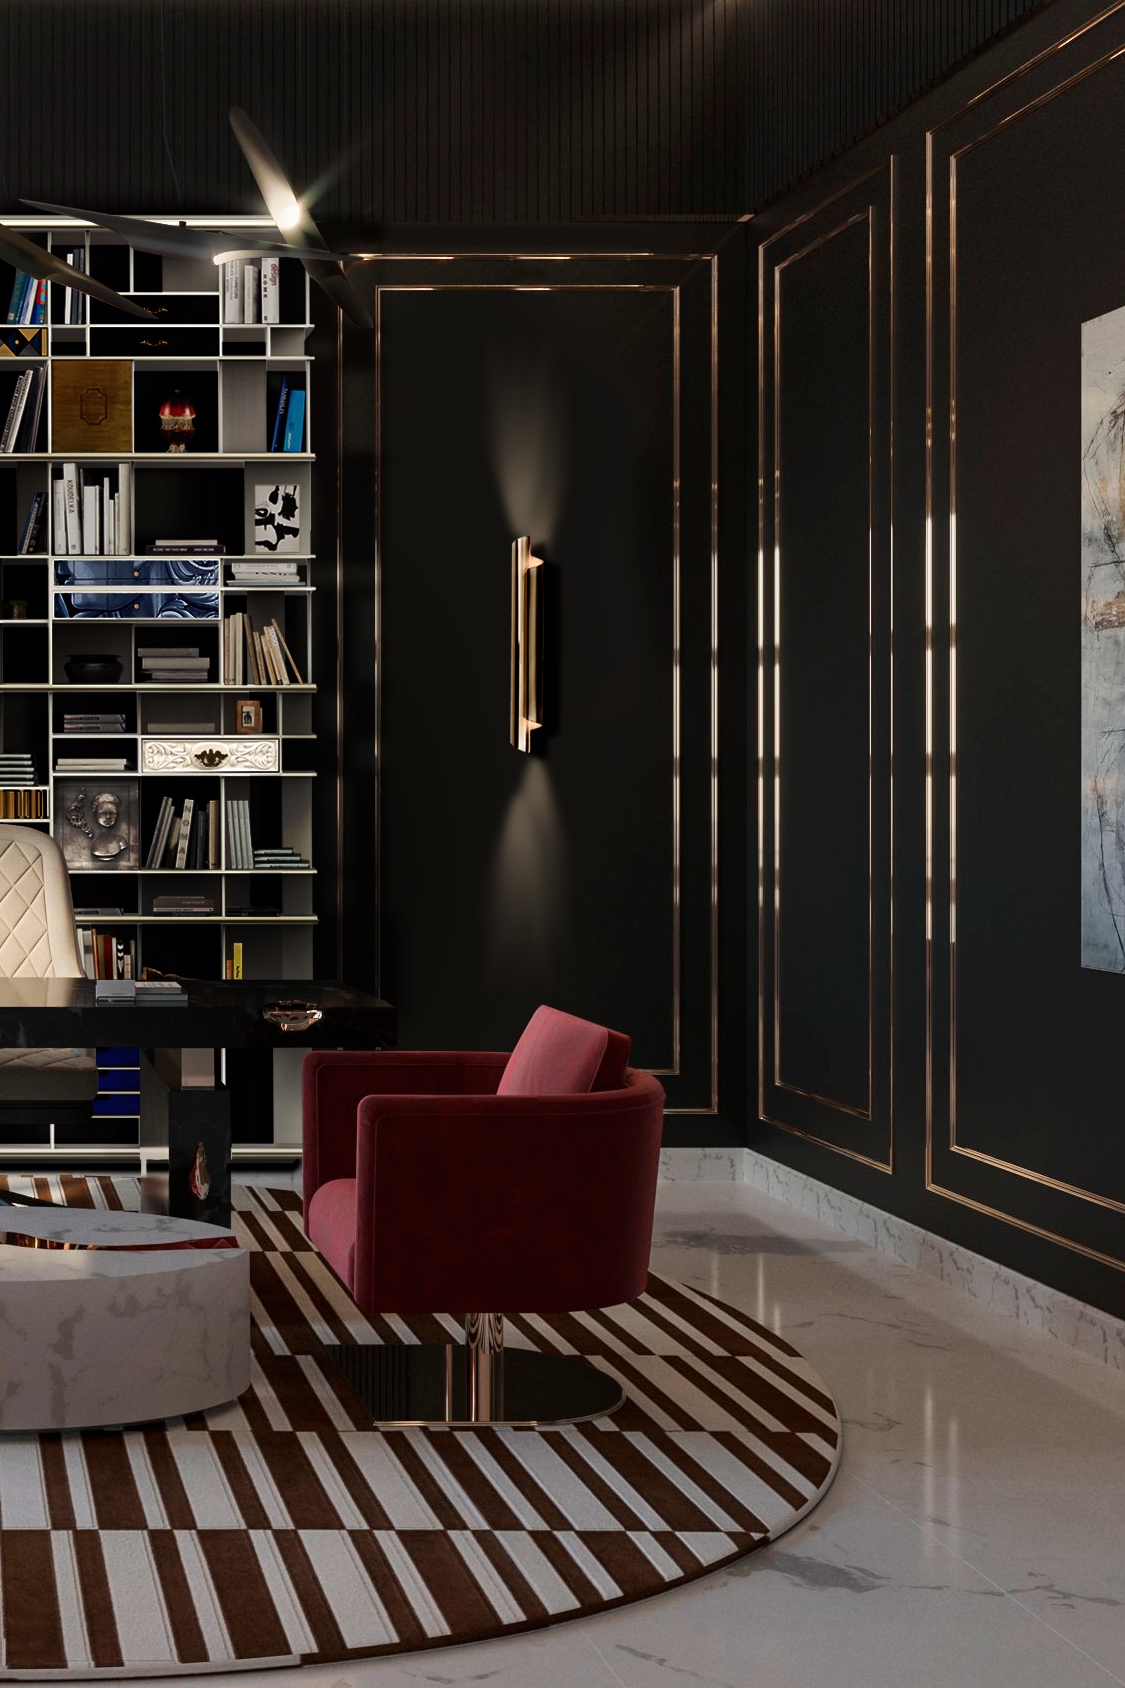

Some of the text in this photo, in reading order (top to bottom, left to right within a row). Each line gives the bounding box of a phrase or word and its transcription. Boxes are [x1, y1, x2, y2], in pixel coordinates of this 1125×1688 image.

[269, 263, 278, 286] design
[66, 479, 75, 514] KOUDELKA
[269, 628, 278, 647] 1000
[179, 805, 192, 854] NOMA
